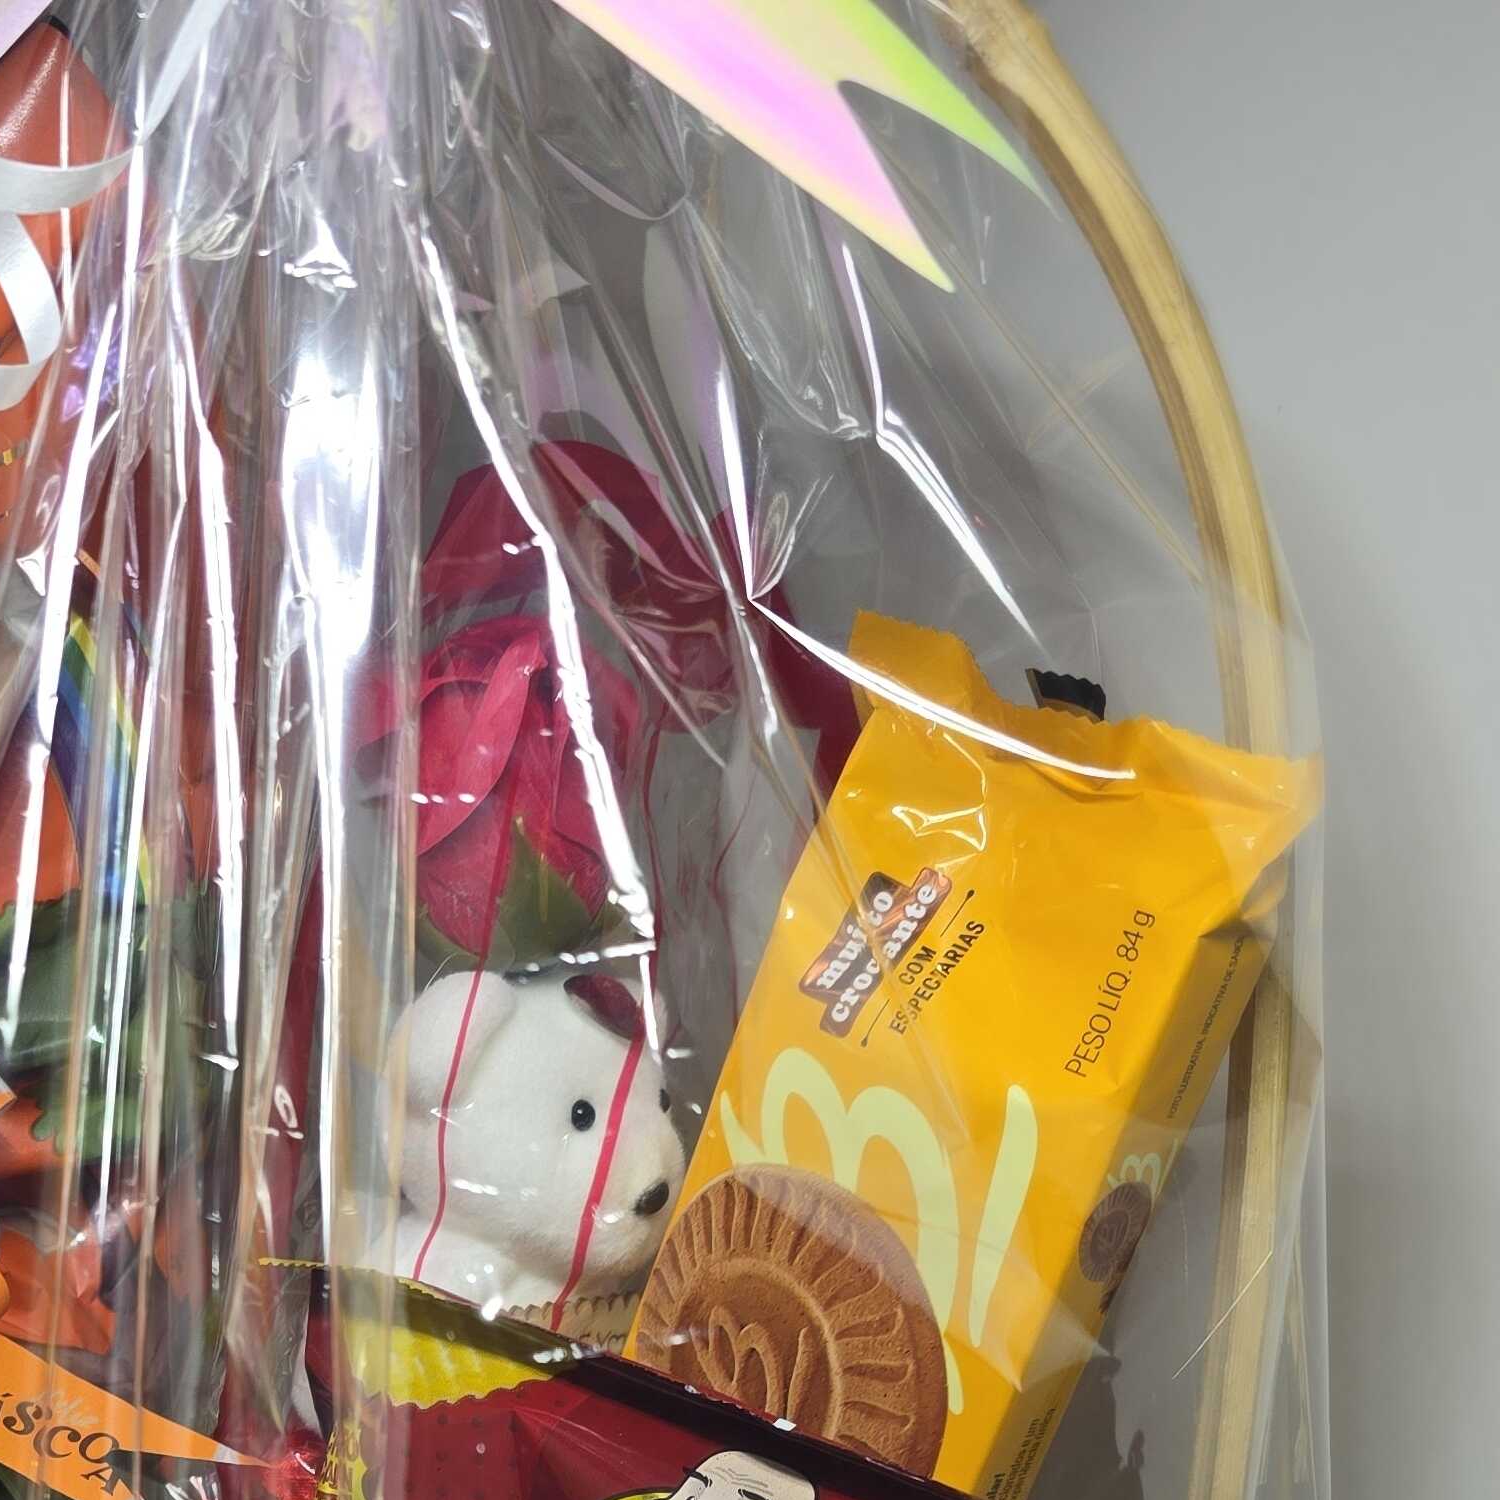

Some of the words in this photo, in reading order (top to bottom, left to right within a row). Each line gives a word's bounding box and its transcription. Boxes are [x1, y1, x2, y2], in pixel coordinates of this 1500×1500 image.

[817, 891, 893, 989] muito
[831, 885, 937, 1022] crocante
[890, 920, 985, 1035] ESPECIARIAS
[899, 945, 937, 985] COM
[1064, 1013, 1112, 1077] PESO
[1097, 970, 1132, 1011] LÍQ.
[1116, 930, 1144, 961] 84
[1133, 910, 1155, 928] g
